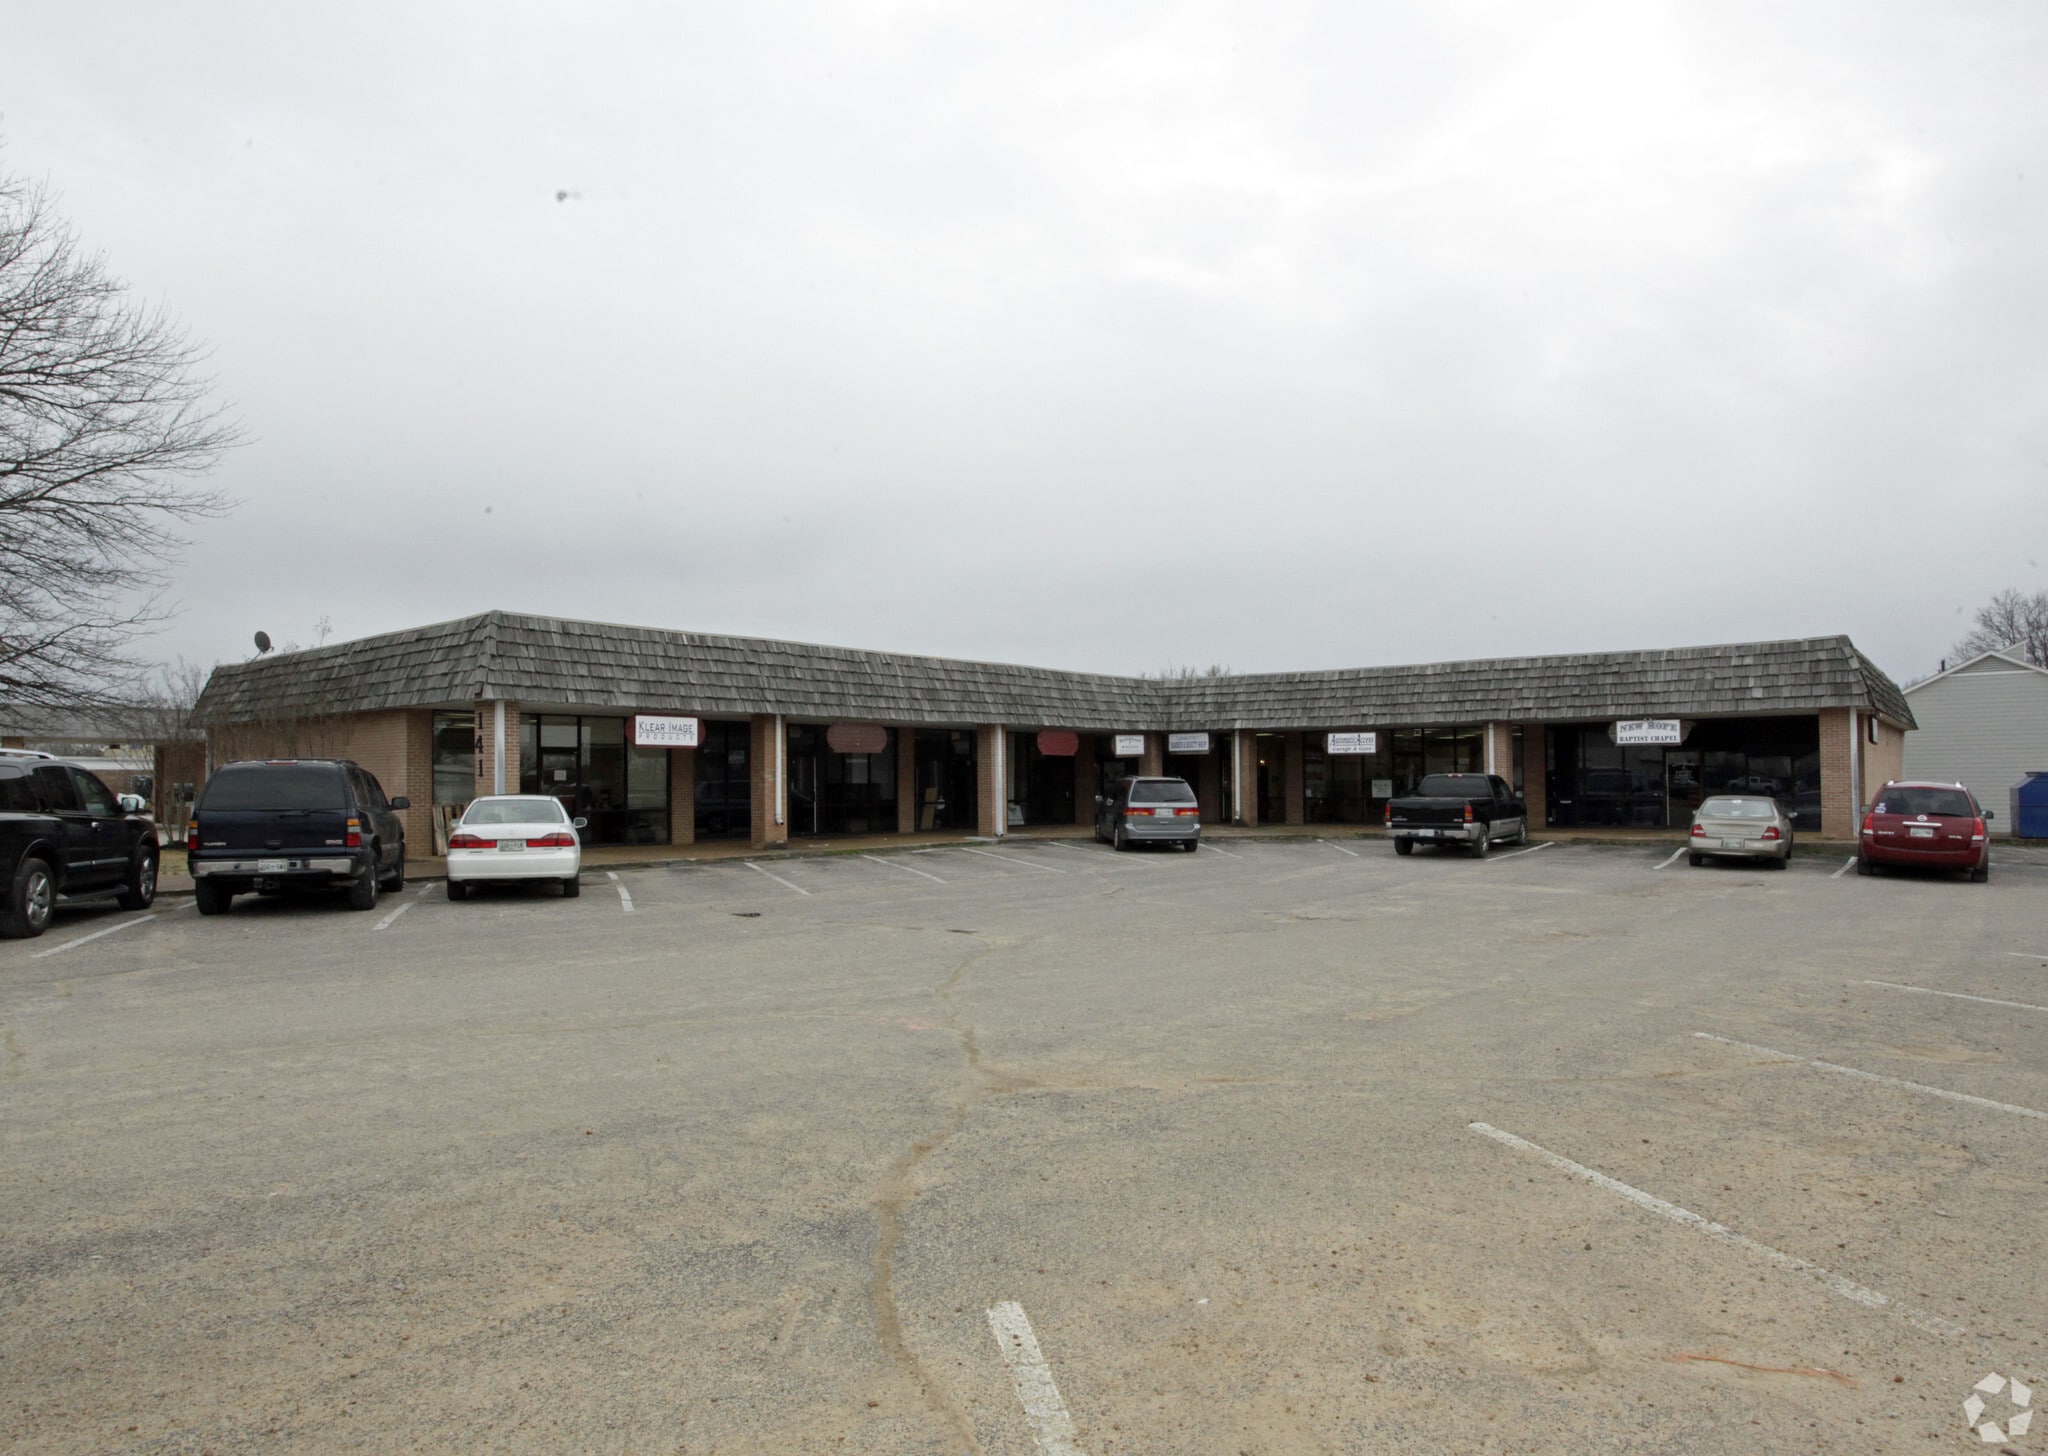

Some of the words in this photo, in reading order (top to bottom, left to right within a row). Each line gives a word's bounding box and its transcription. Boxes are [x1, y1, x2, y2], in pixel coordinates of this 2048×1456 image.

[639, 721, 665, 732] KLEAR
[669, 722, 693, 733] IMAGE
[1619, 723, 1643, 733] NEW
[1647, 722, 1678, 731] HOPE
